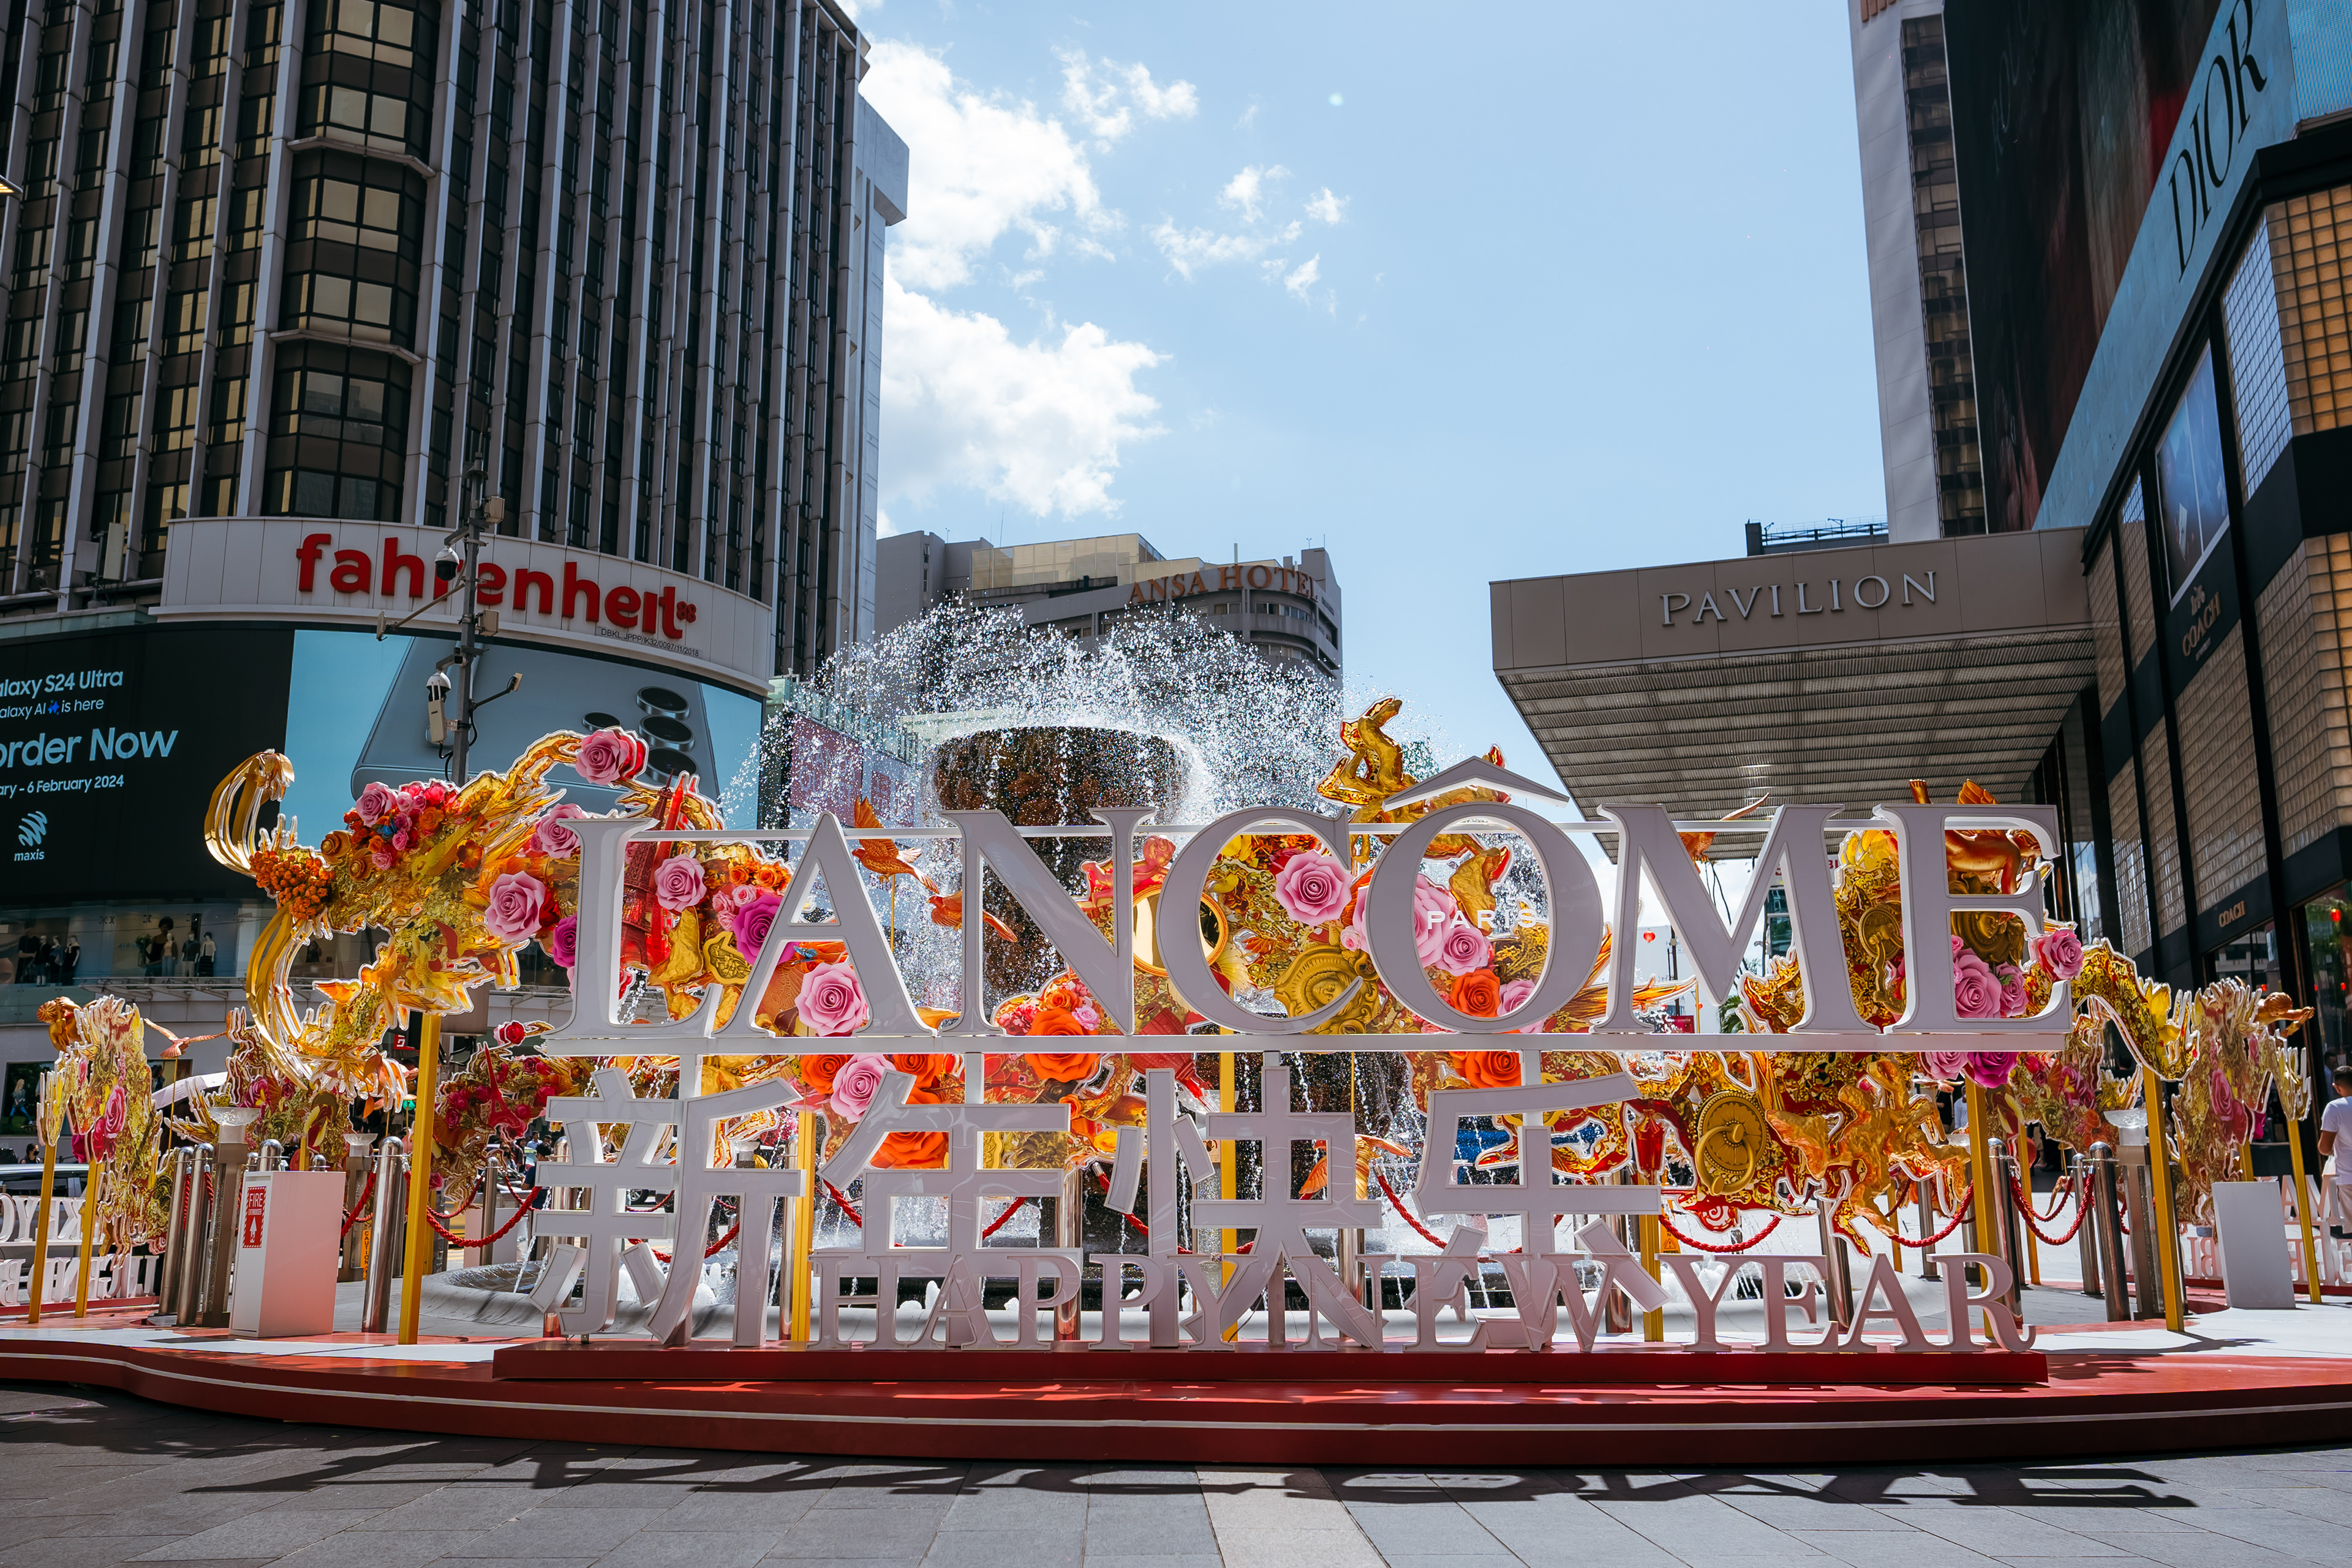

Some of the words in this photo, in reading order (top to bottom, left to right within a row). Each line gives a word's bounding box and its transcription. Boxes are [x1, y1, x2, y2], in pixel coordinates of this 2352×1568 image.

[2168, 0, 2267, 284] DIOR
[1126, 570, 1208, 605] ANSA
[1217, 564, 1319, 603] HOTEL
[1659, 570, 1937, 627] PAVILION
[2182, 591, 2222, 657] COACH
[0, 678, 43, 699] laxy
[44, 673, 75, 693] S24
[79, 669, 124, 689] Ultra
[34, 703, 47, 715] AI
[61, 700, 71, 712] is
[74, 699, 104, 712] here
[89, 727, 178, 761] Now
[27, 781, 34, 793] 6
[36, 778, 92, 793] February
[94, 774, 124, 788] 2024
[14, 849, 45, 861] maxis
[541, 755, 2073, 1037] LANCÔME
[1427, 908, 1537, 930] PARIS
[2218, 900, 2246, 927] COACH
[248, 1193, 264, 1208] FIRE
[529, 1066, 1673, 1348] 新年快乐
[807, 1253, 1258, 1352] HAPPY
[1291, 1253, 1630, 1352] NEW
[1654, 1253, 2037, 1353] YEAR
